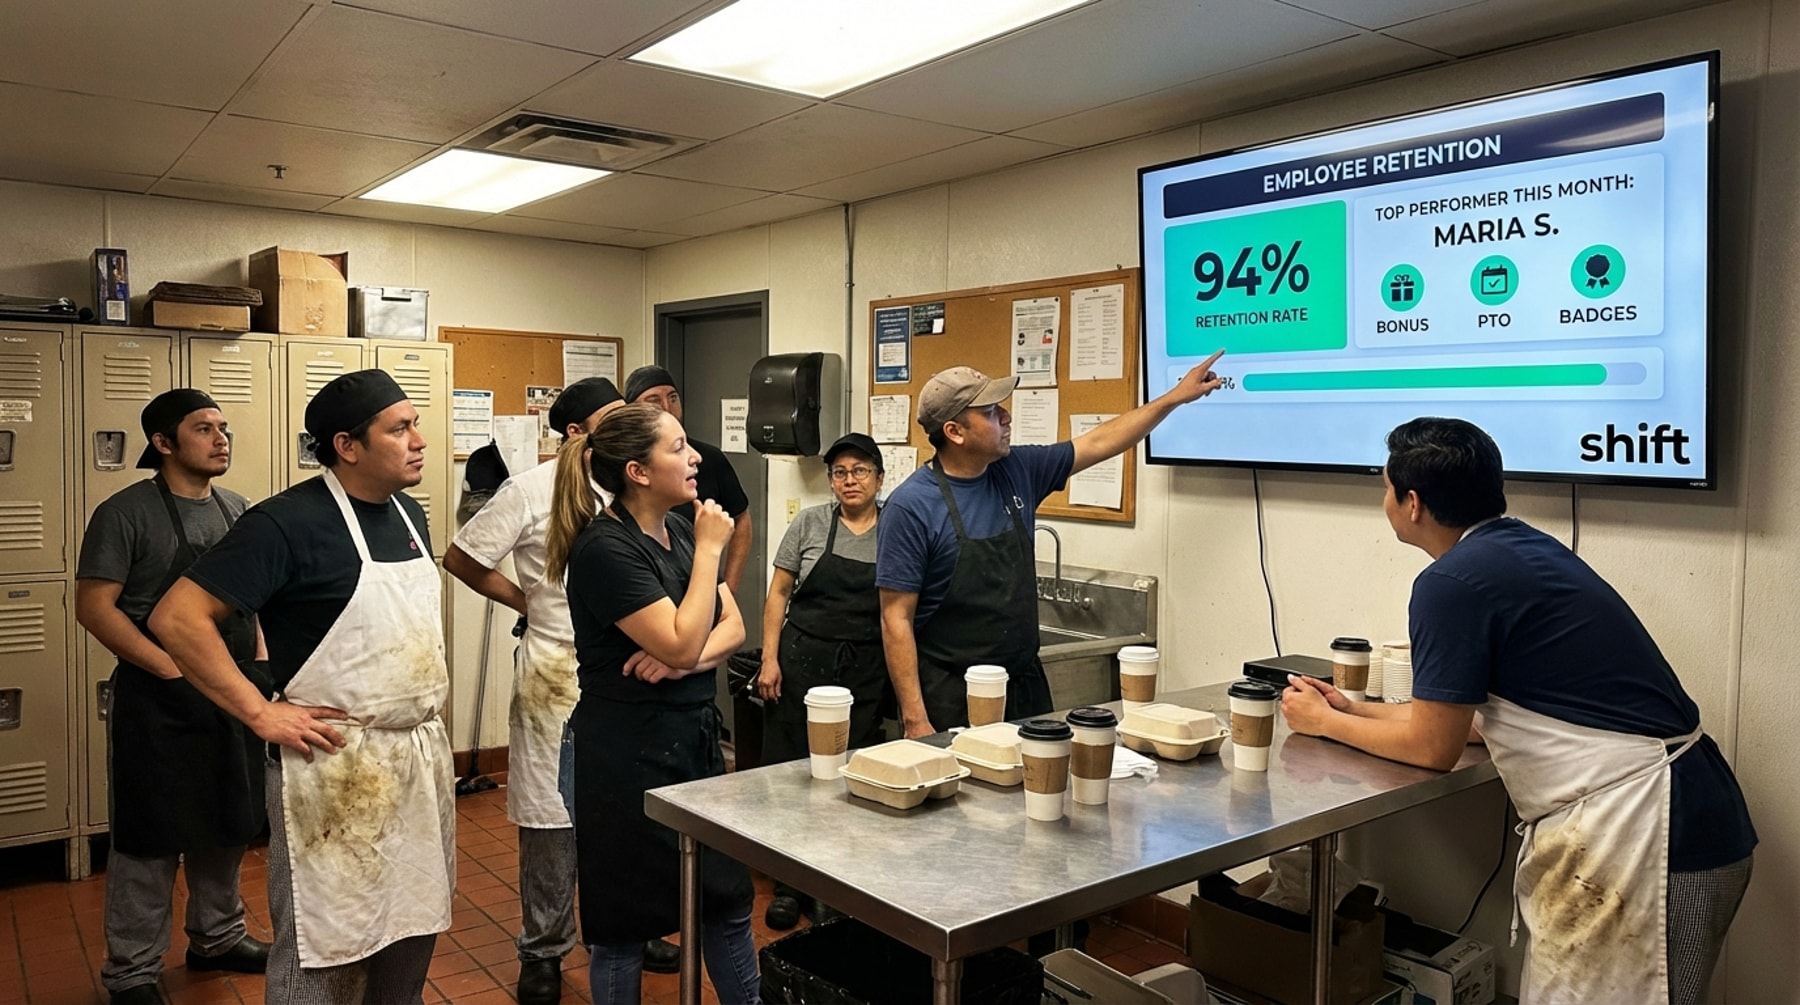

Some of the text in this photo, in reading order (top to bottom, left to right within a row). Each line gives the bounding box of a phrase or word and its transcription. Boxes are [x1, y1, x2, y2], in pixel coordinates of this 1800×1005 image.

[1263, 135, 1501, 193] EMPLOYEE RETENTION
[1374, 173, 1634, 222] TOP PERFORMER THIS MONTH:
[1434, 212, 1560, 248] MARIA S.
[1193, 240, 1310, 302] 94%
[1195, 307, 1308, 328] RETENTION RATE
[1376, 318, 1430, 334] BONUS
[1478, 313, 1512, 328] PTO
[1559, 305, 1637, 324] BADGES
[1580, 422, 1691, 465] shift
